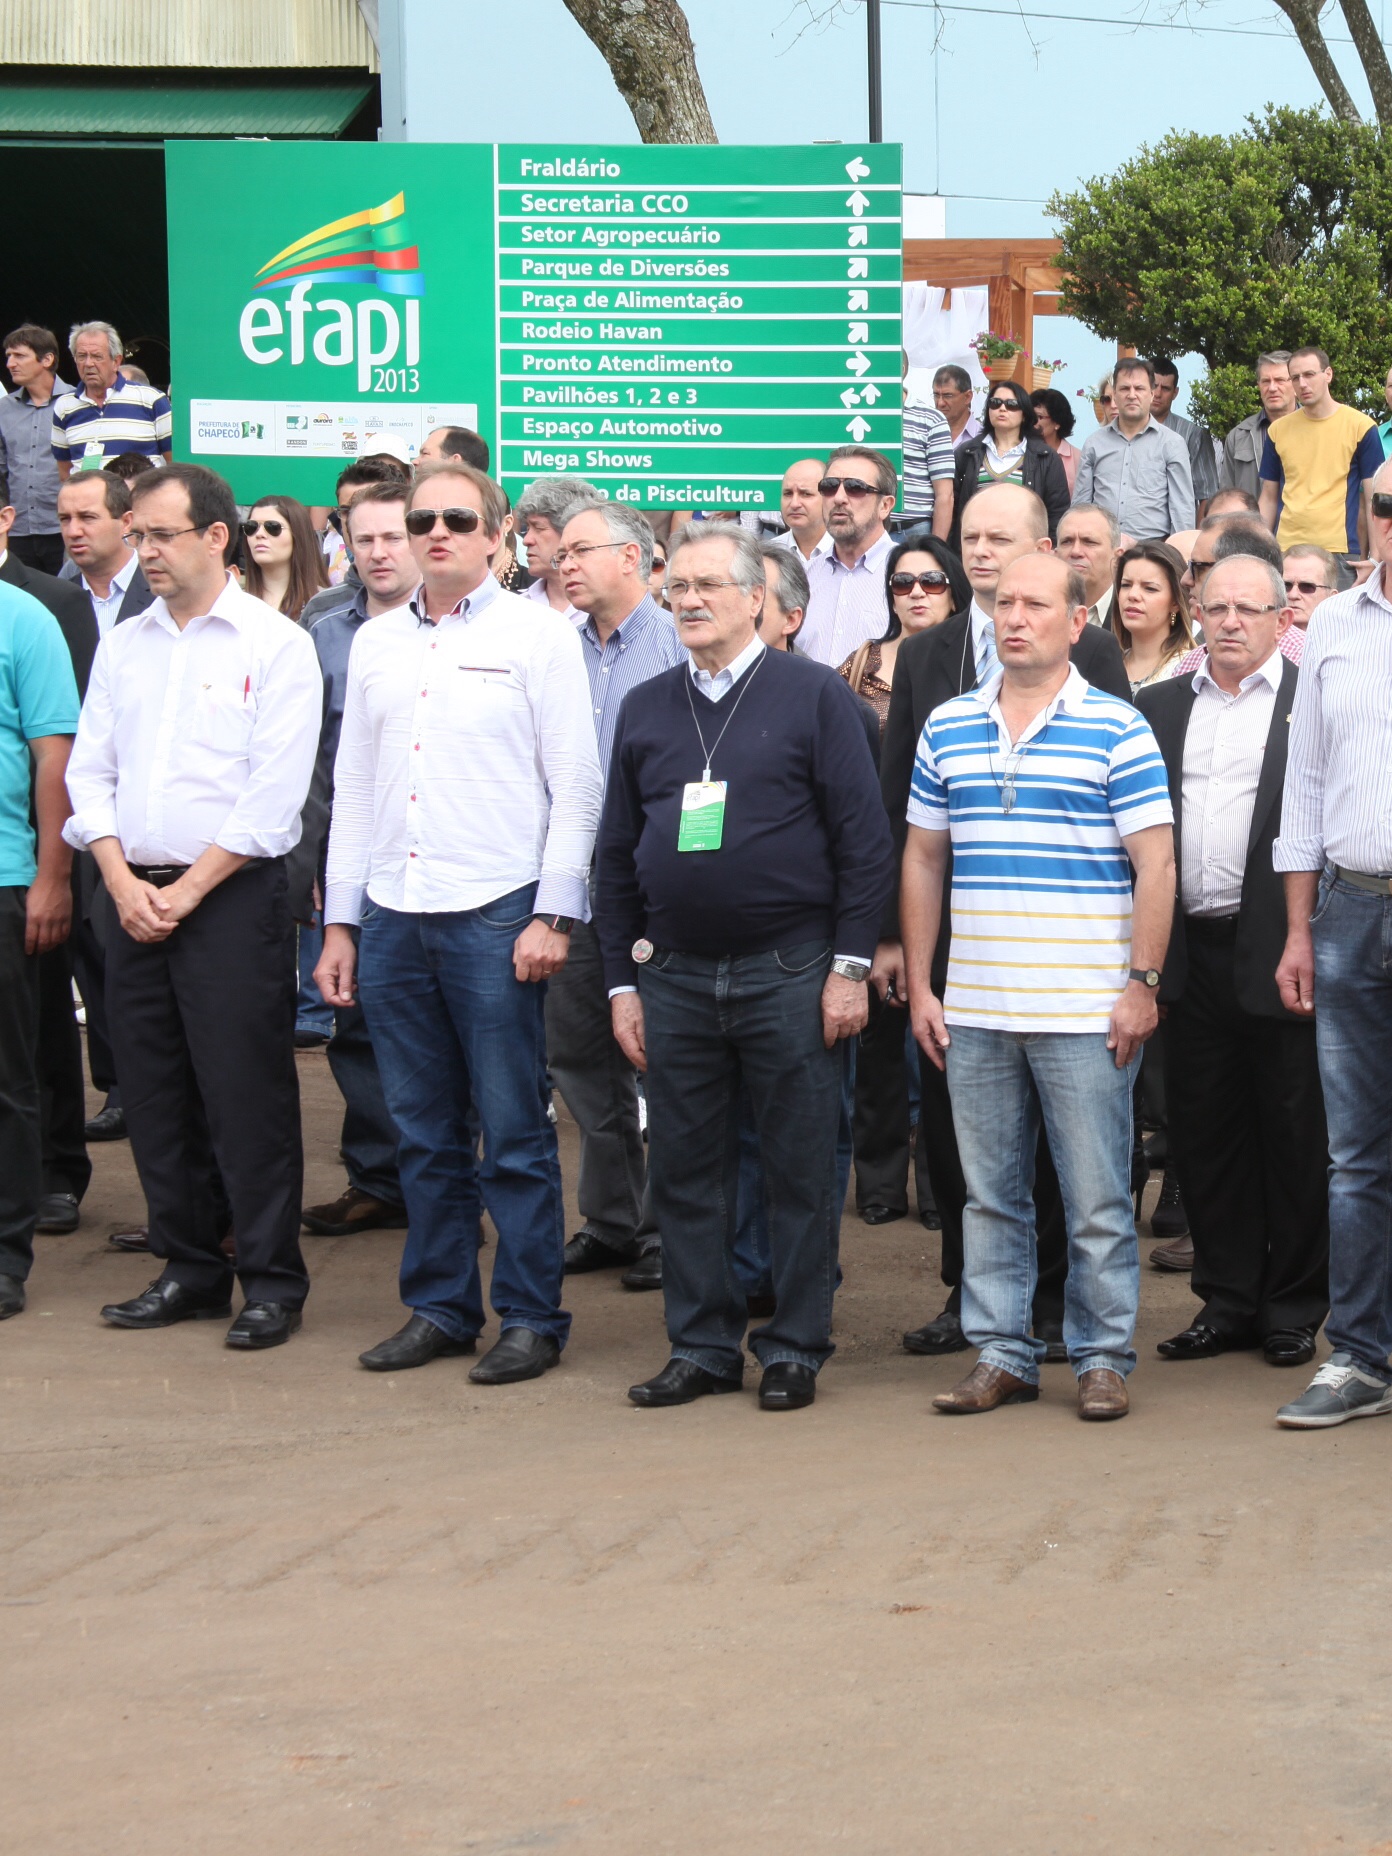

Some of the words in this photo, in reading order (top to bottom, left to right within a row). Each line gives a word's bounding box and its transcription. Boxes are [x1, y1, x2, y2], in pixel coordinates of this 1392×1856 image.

[520, 157, 621, 178] Fraldário
[521, 193, 635, 213] Secretaria
[641, 194, 689, 214] CCO
[521, 225, 577, 243] Setor
[581, 225, 721, 248] Agropecuário
[521, 258, 593, 280] Parque
[598, 258, 625, 276] de
[630, 258, 730, 277] Diversões
[522, 290, 578, 313] Praça
[583, 290, 609, 308] de
[614, 290, 744, 313] Alimentação
[239, 279, 420, 393] efapi
[522, 321, 594, 339] Rodeio
[599, 323, 663, 340] Havan
[522, 354, 592, 372] Pronto
[597, 354, 733, 373] Atendimento
[373, 368, 420, 393] 2013
[523, 385, 619, 404] Pavilhões
[625, 387, 643, 407] 1,
[649, 387, 662, 405] 2
[667, 391, 680, 405] e
[685, 388, 698, 405] 3
[198, 427, 240, 438] CHAPECÓ
[523, 417, 594, 439] Espaço
[599, 418, 723, 436] Automotivo
[523, 449, 580, 471] Mega
[585, 449, 653, 468] Shows
[615, 484, 641, 502] da
[647, 484, 765, 503] Piscicultura
